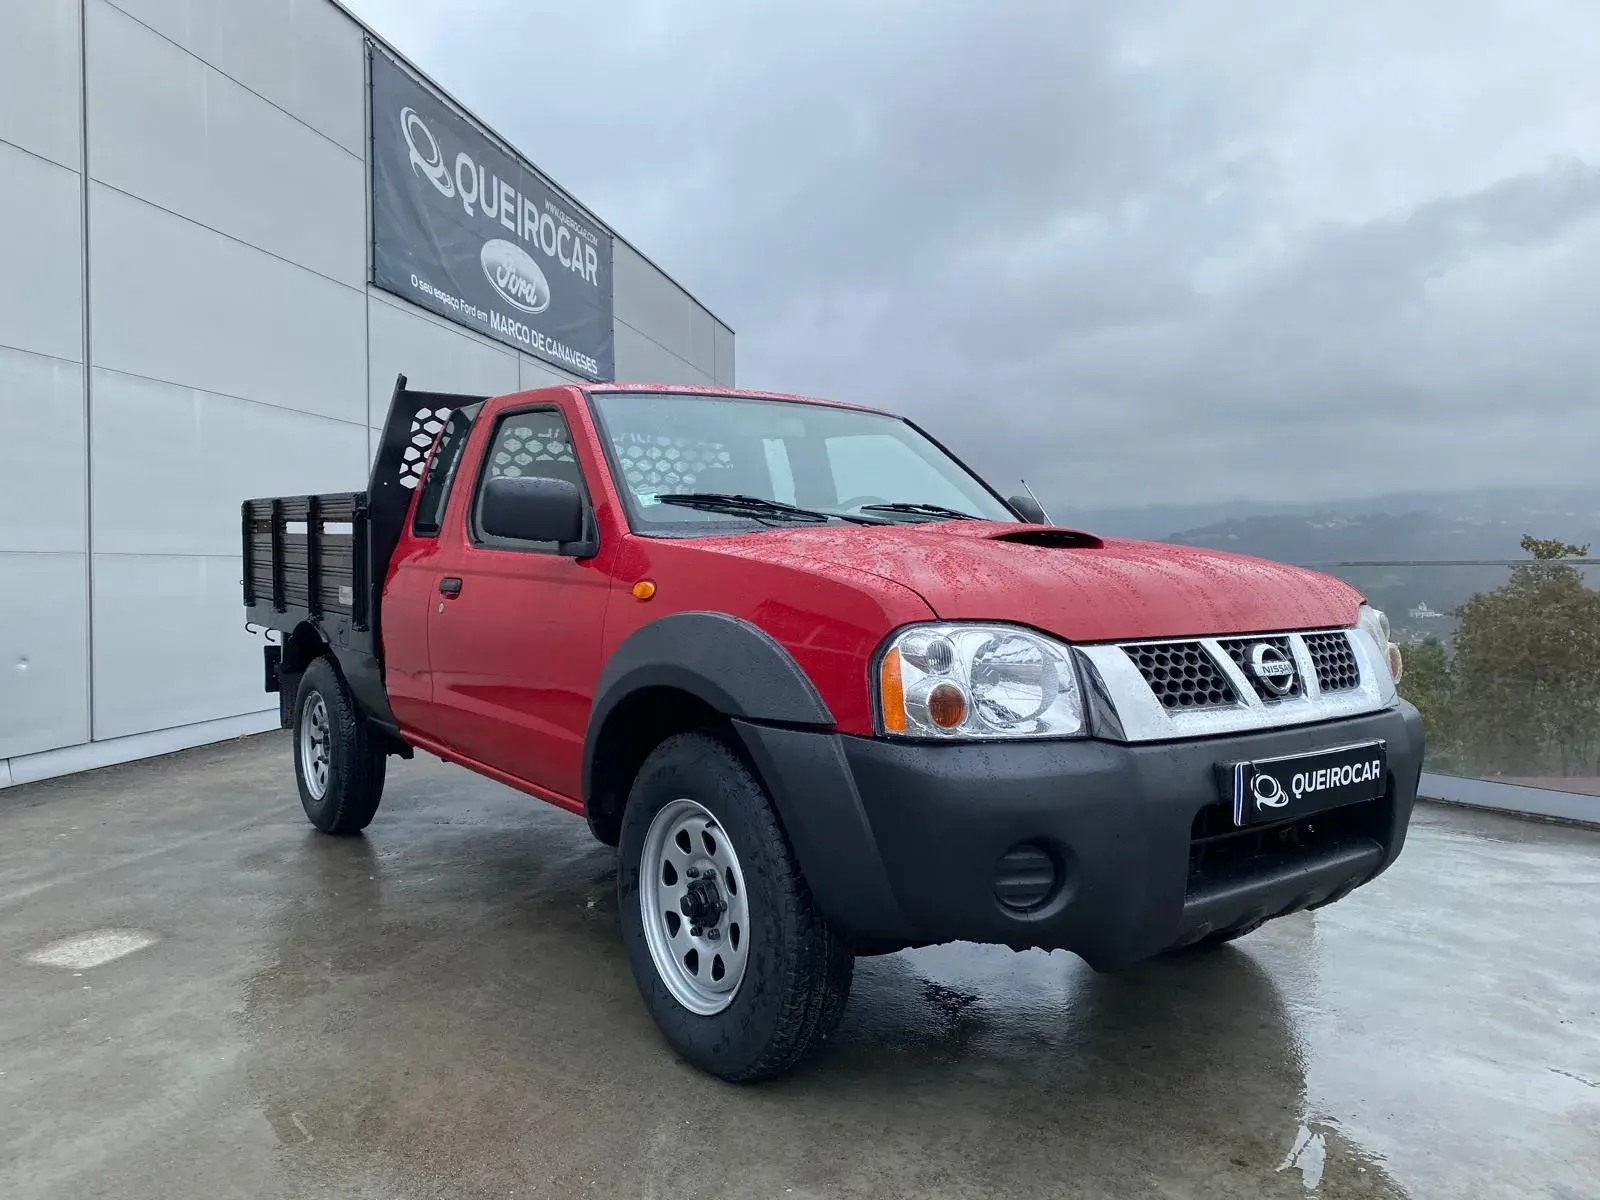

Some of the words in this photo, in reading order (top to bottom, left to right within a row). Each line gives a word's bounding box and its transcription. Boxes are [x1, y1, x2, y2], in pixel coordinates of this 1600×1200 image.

[455, 152, 597, 286] QUEIROCAR
[496, 254, 537, 306] Ford
[411, 273, 418, 288] O
[419, 280, 433, 295] seu
[433, 288, 460, 310] espaço
[460, 298, 476, 318] Ford
[476, 309, 488, 322] em
[490, 309, 530, 344] MARCO
[531, 330, 545, 352] DE
[545, 338, 598, 375] CANAVESES
[1291, 759, 1381, 799] QUEIROCAR
